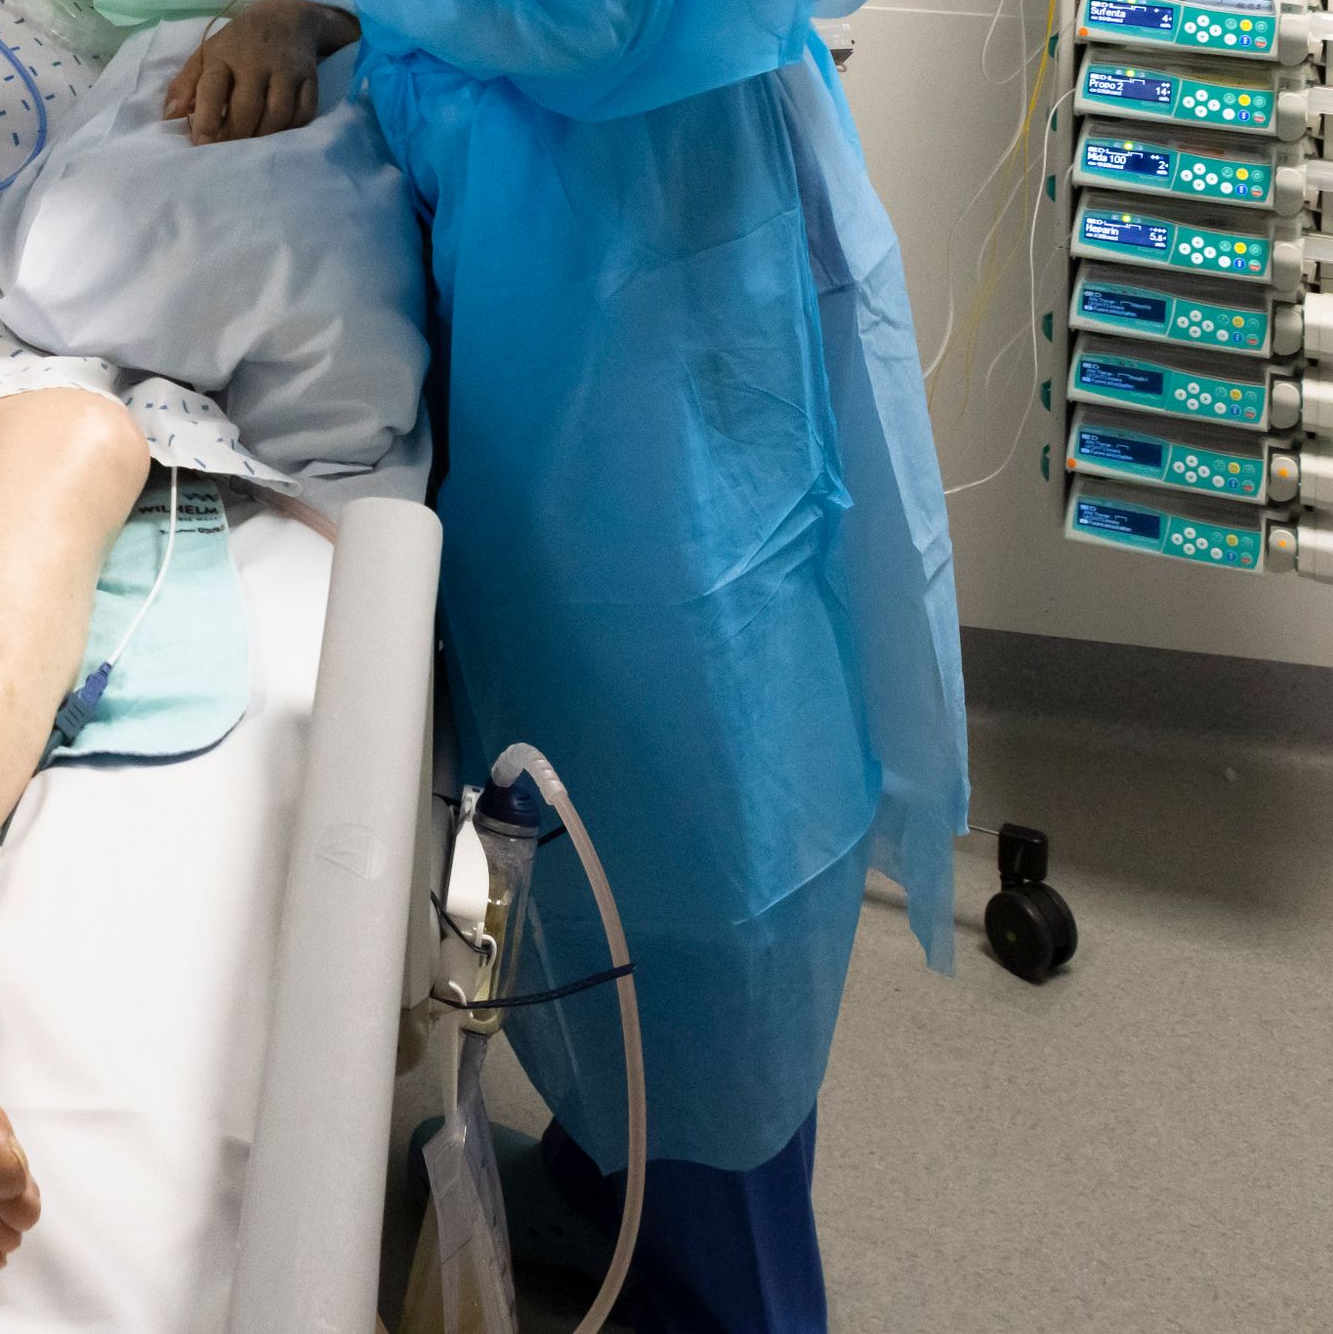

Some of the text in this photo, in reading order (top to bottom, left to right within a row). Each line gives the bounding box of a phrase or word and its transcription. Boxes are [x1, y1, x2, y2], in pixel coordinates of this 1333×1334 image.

[1090, 6, 1168, 23] Sufenta 4
[1089, 79, 1167, 96] Propo 2 14
[1087, 152, 1165, 169] Mida 100 2
[1085, 223, 1119, 236] Heparin
